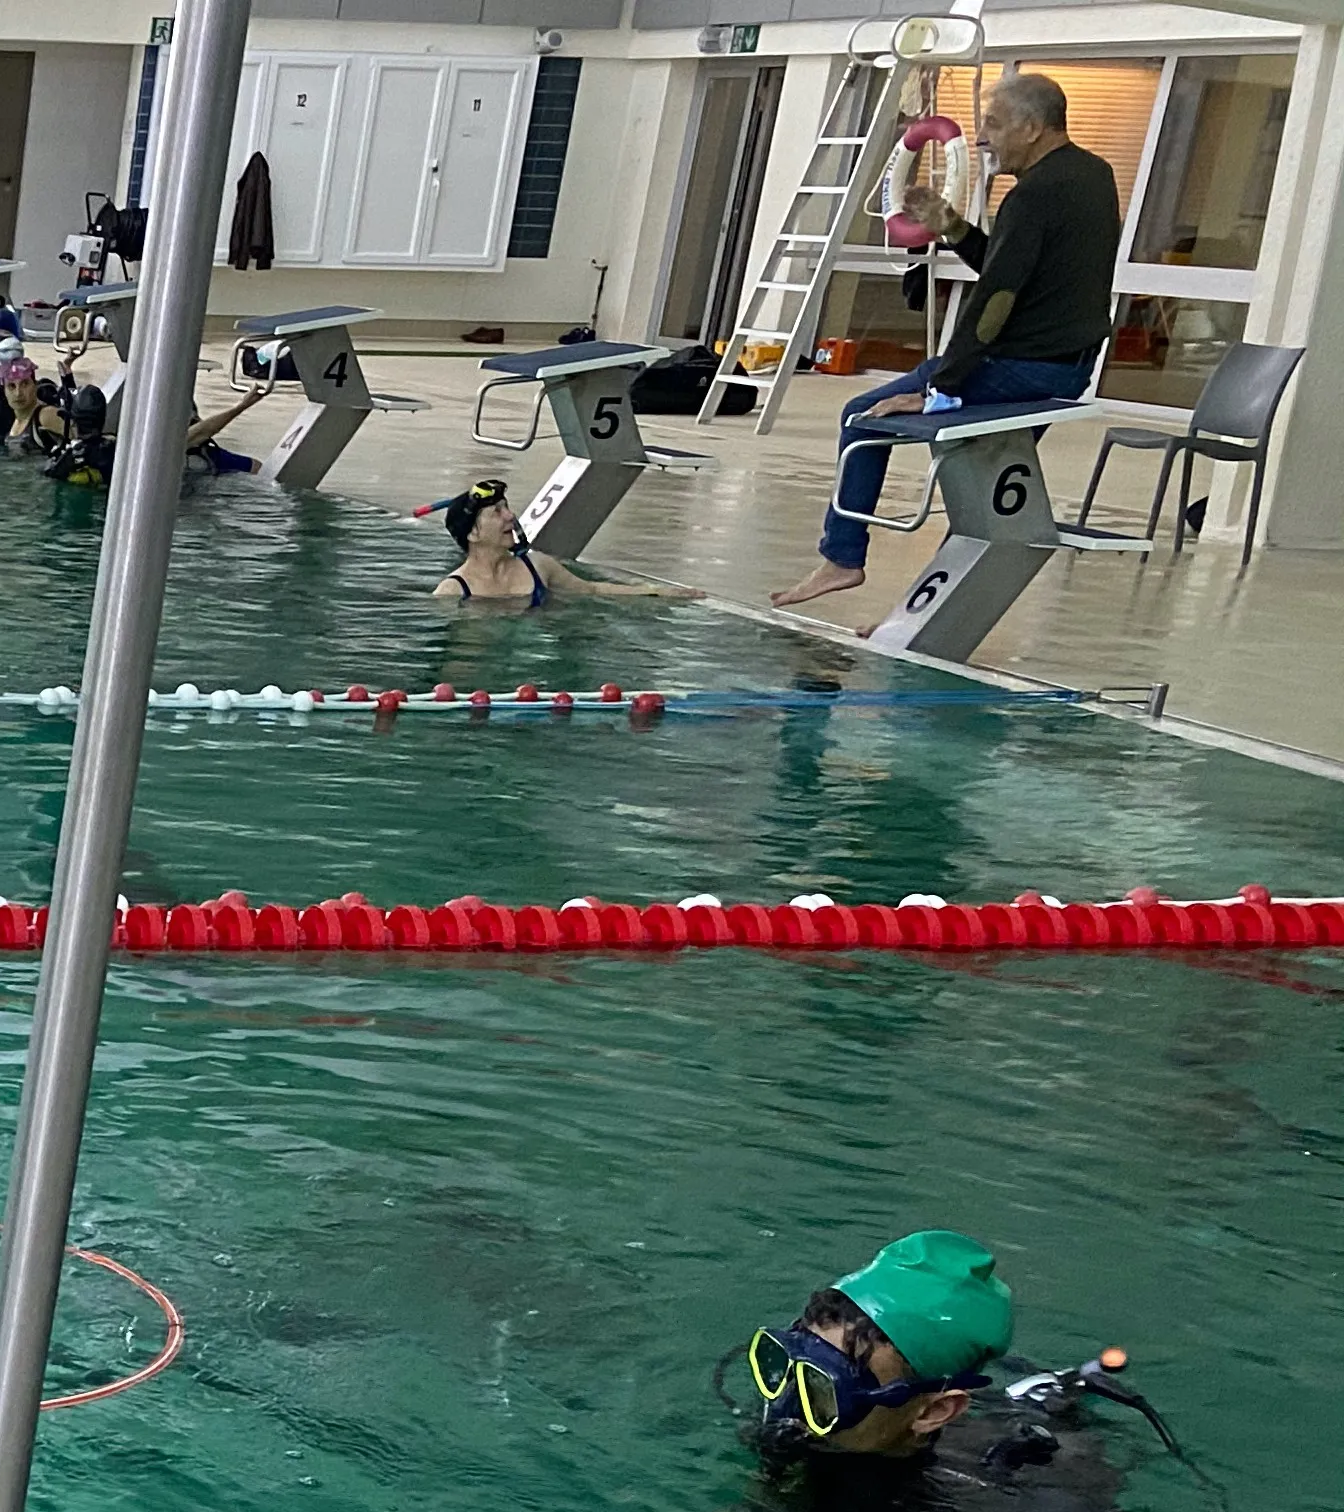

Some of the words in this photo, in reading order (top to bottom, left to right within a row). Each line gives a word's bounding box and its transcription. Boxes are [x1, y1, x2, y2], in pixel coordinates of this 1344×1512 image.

[296, 94, 307, 108] 12
[472, 99, 482, 112] 11
[323, 352, 349, 388] 4
[589, 396, 623, 440] 5
[280, 425, 304, 451] 4
[530, 483, 565, 521] 5
[992, 463, 1032, 517] 6
[906, 570, 949, 615] 6
